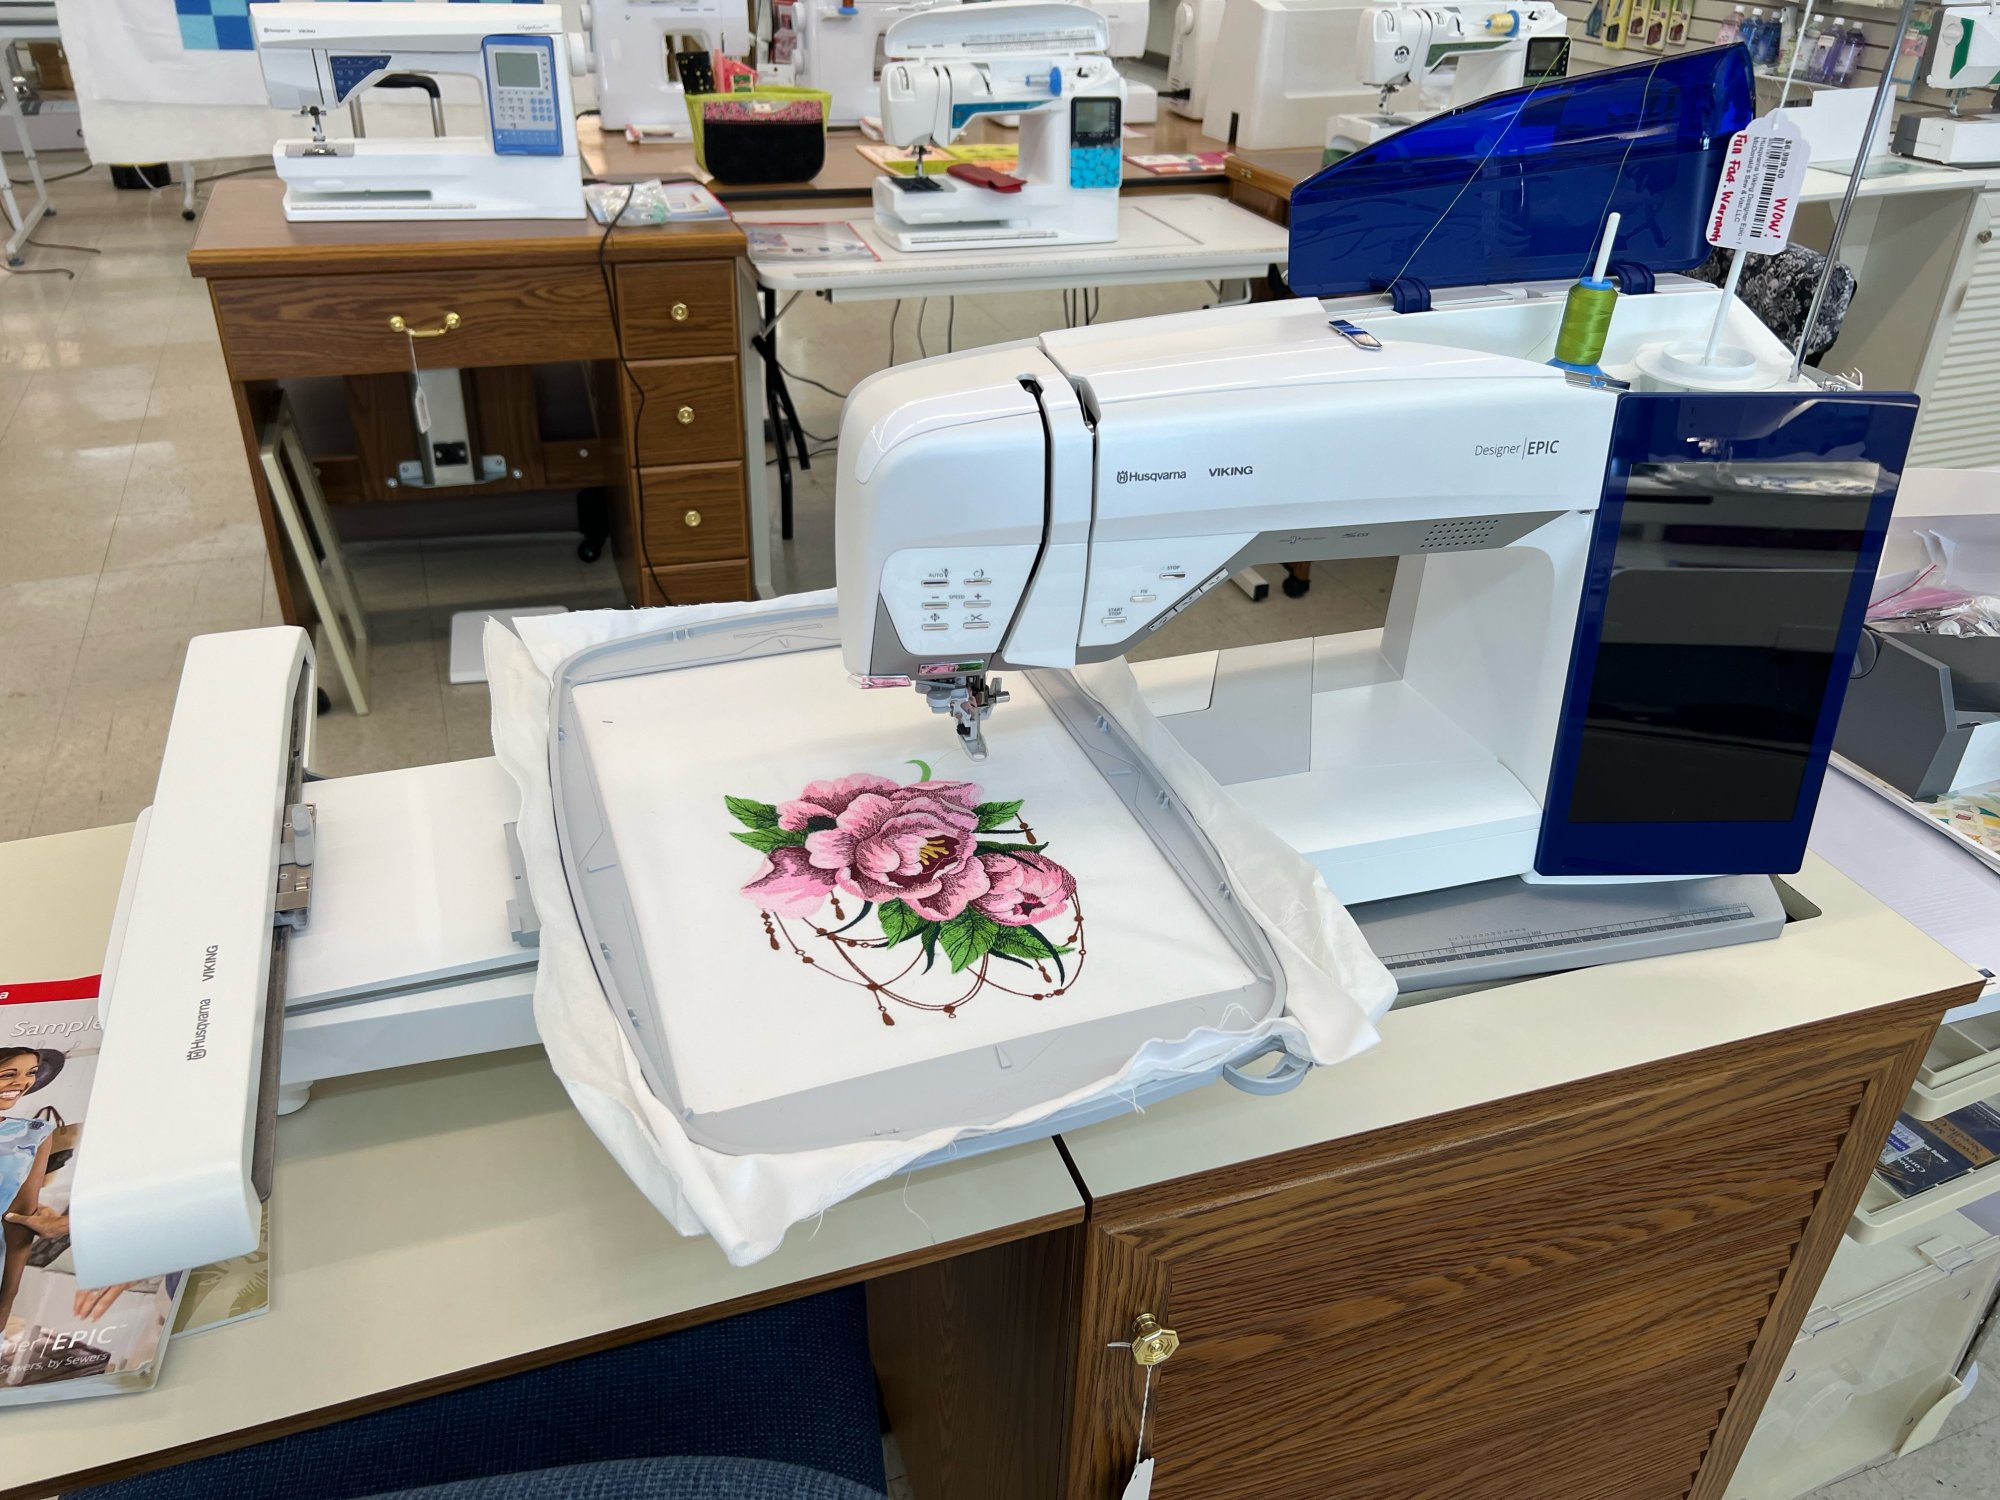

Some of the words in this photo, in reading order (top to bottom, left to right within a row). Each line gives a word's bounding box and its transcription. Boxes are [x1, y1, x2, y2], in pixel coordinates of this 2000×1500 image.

[1731, 134, 1748, 155] Fun
[1754, 137, 1768, 171] Husqvarna
[1777, 140, 1792, 179] $6,999.00
[1748, 173, 1759, 192] Viking
[1764, 198, 1788, 238] WOW!
[1474, 444, 1521, 458] Designer
[1527, 439, 1560, 456] EPIC
[1128, 470, 1187, 483] Husqvarna
[1208, 465, 1254, 478] VIKING
[189, 998, 212, 1050] Husqvarna
[201, 944, 219, 982] VIKING
[51, 1325, 118, 1351] EPIC
[47, 1358, 65, 1370] by
[64, 1352, 108, 1367] Sewers
